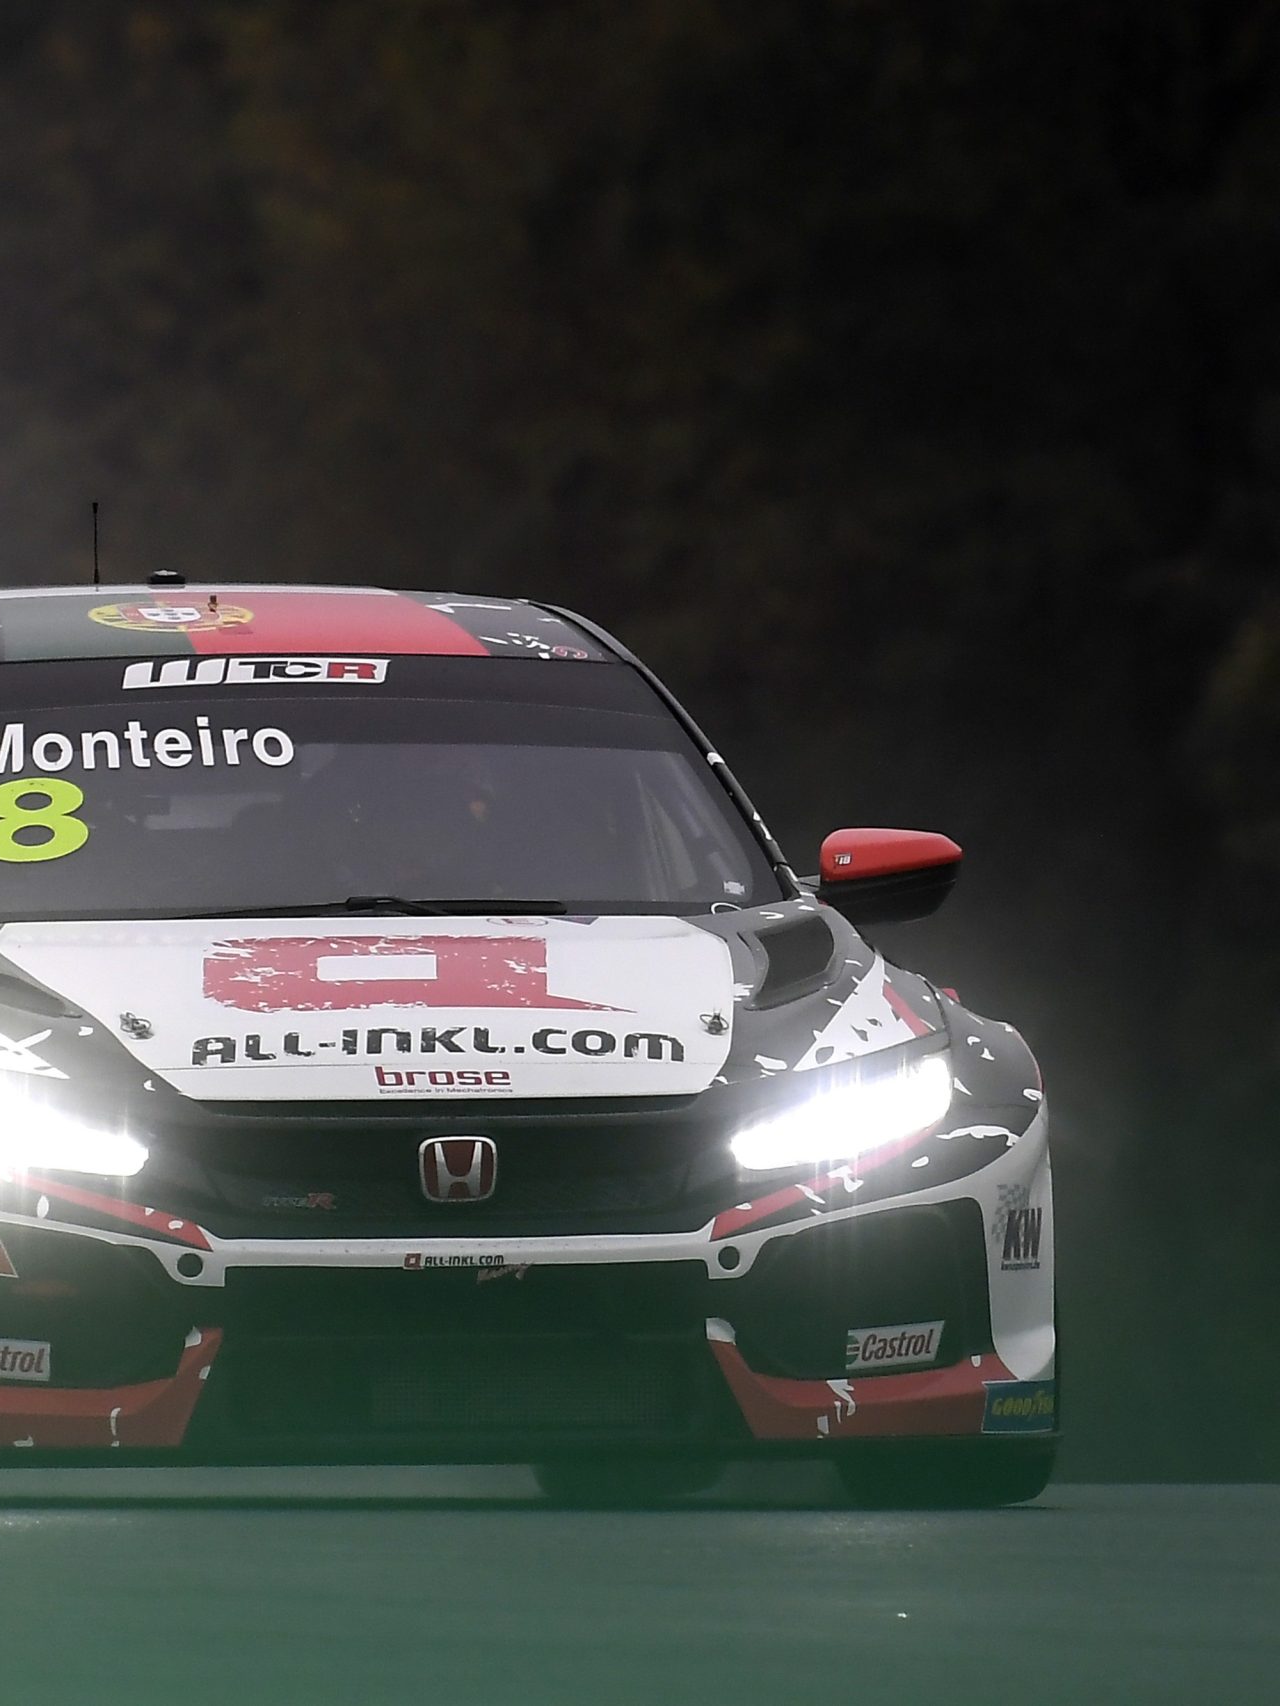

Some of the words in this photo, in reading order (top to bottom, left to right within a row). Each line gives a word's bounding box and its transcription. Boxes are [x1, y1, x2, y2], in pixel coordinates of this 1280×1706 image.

[122, 657, 382, 690] WTCR
[374, 1066, 512, 1087] brose
[1002, 1207, 1043, 1261] KW
[860, 1328, 934, 1362] Castrol
